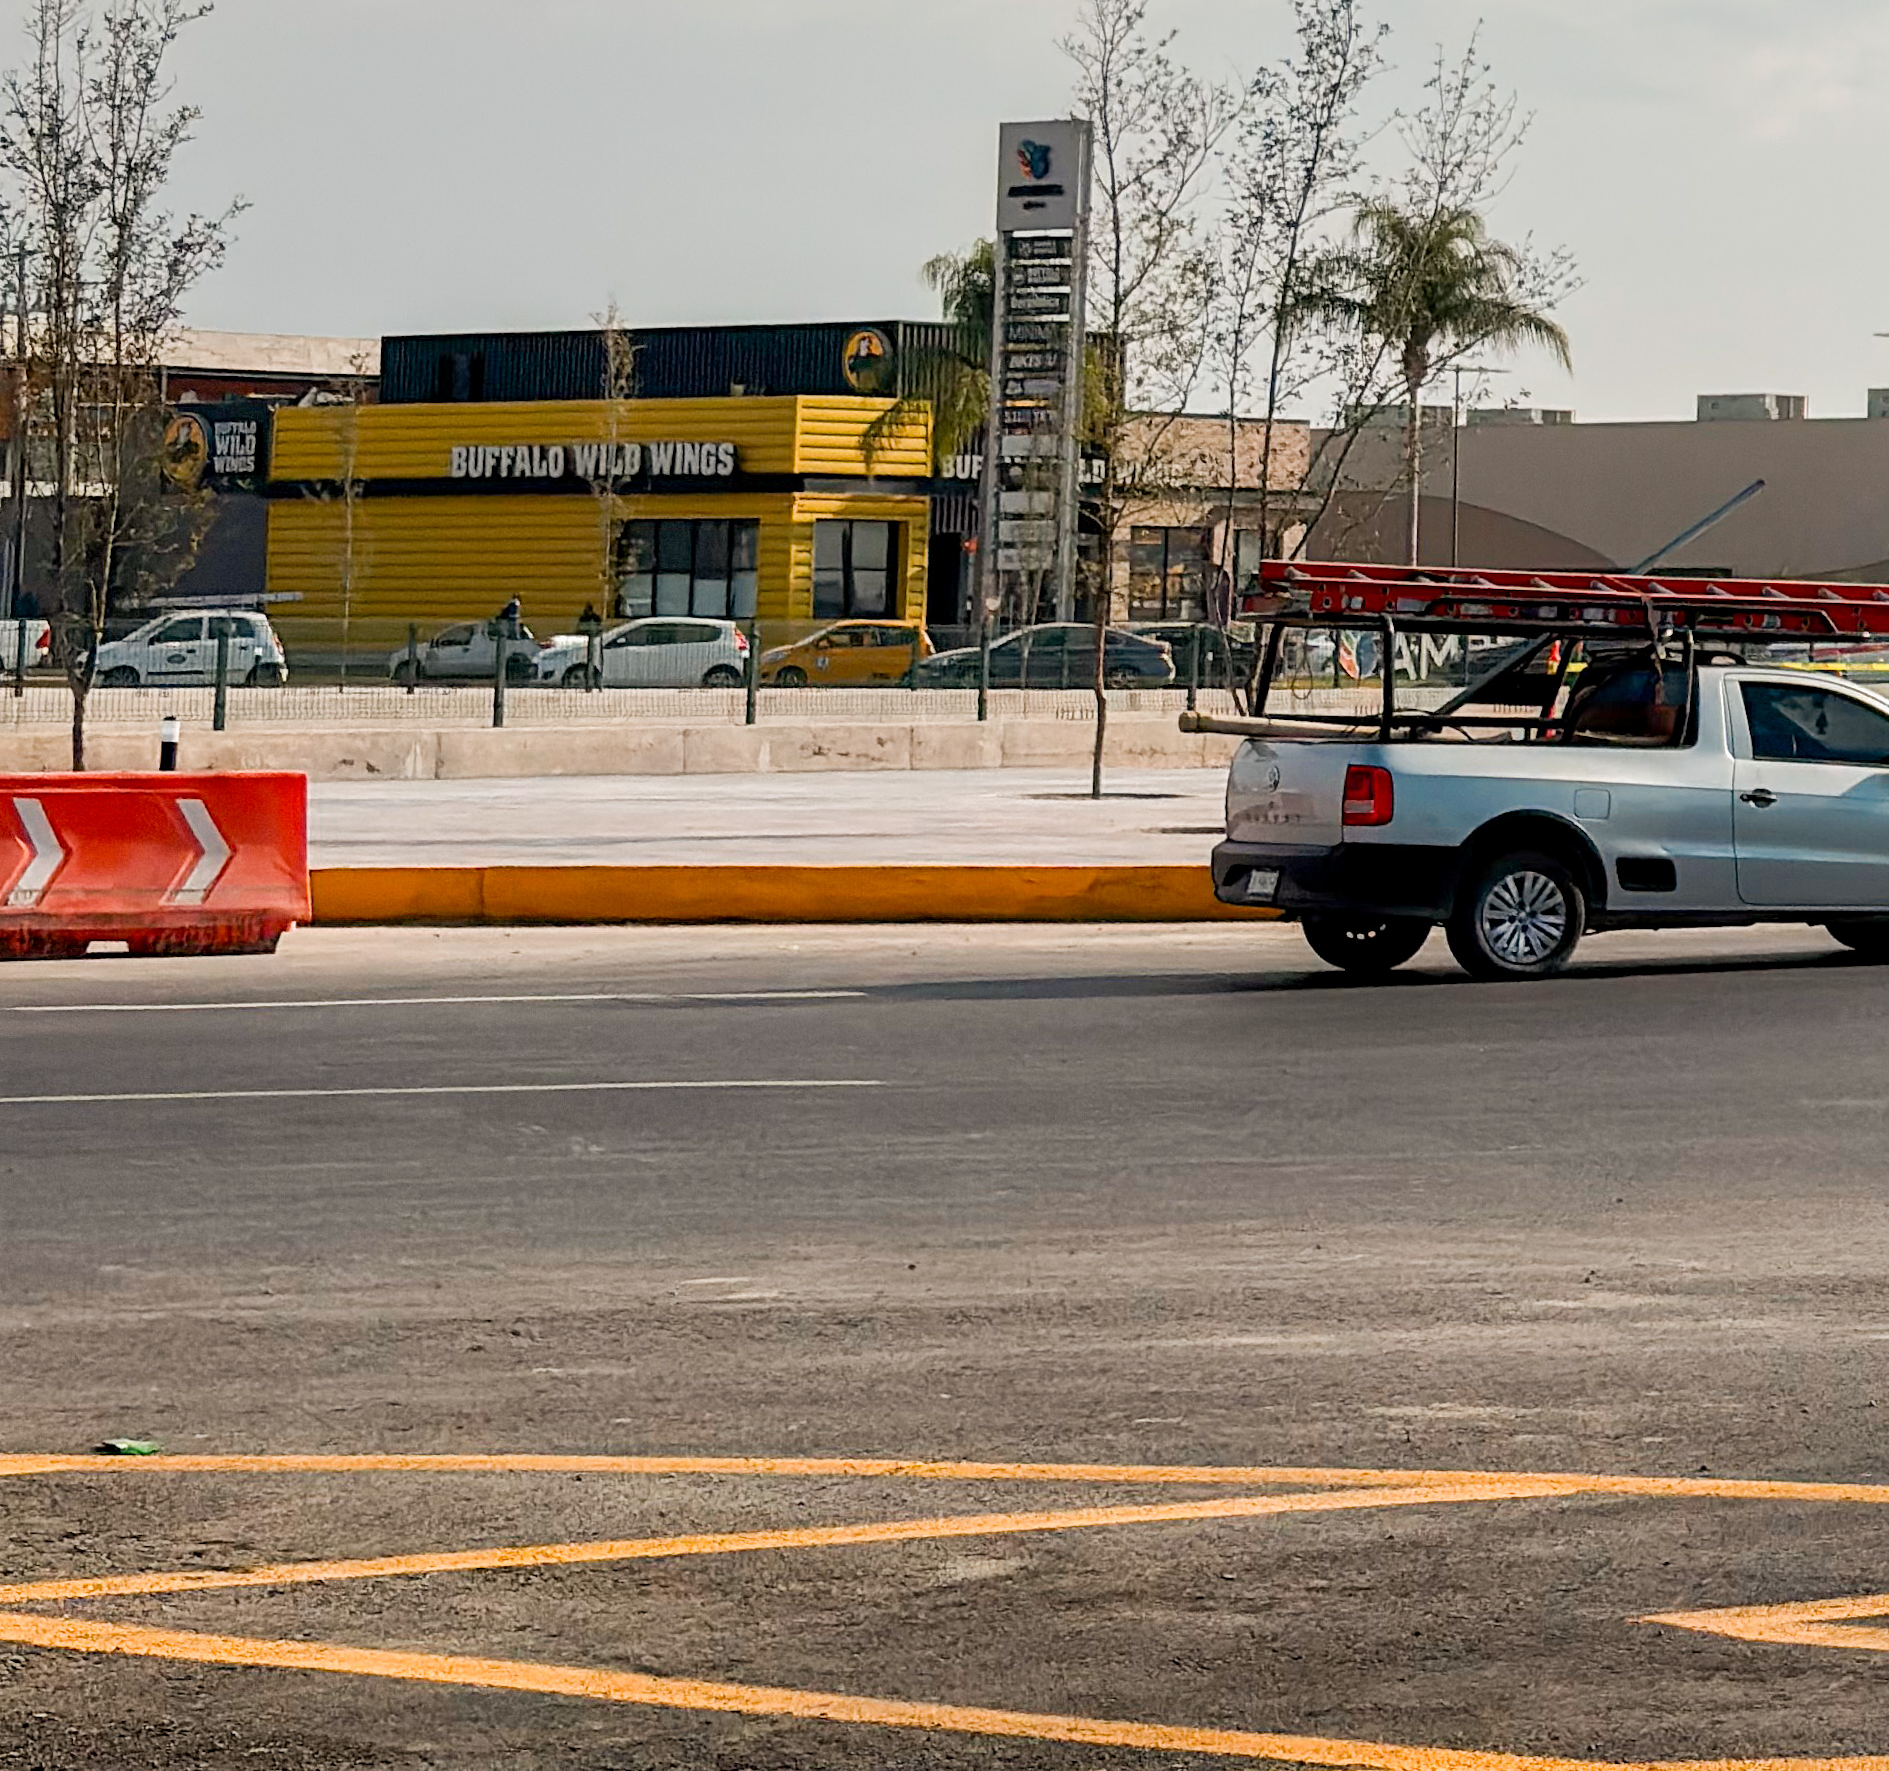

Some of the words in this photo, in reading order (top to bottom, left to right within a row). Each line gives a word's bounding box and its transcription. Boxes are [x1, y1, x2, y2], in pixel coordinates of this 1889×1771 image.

[215, 434, 256, 456] WILD
[213, 455, 255, 474] WINGS
[451, 445, 565, 478] BUFFALO
[574, 443, 641, 476] WILD
[650, 442, 734, 476] WINGS
